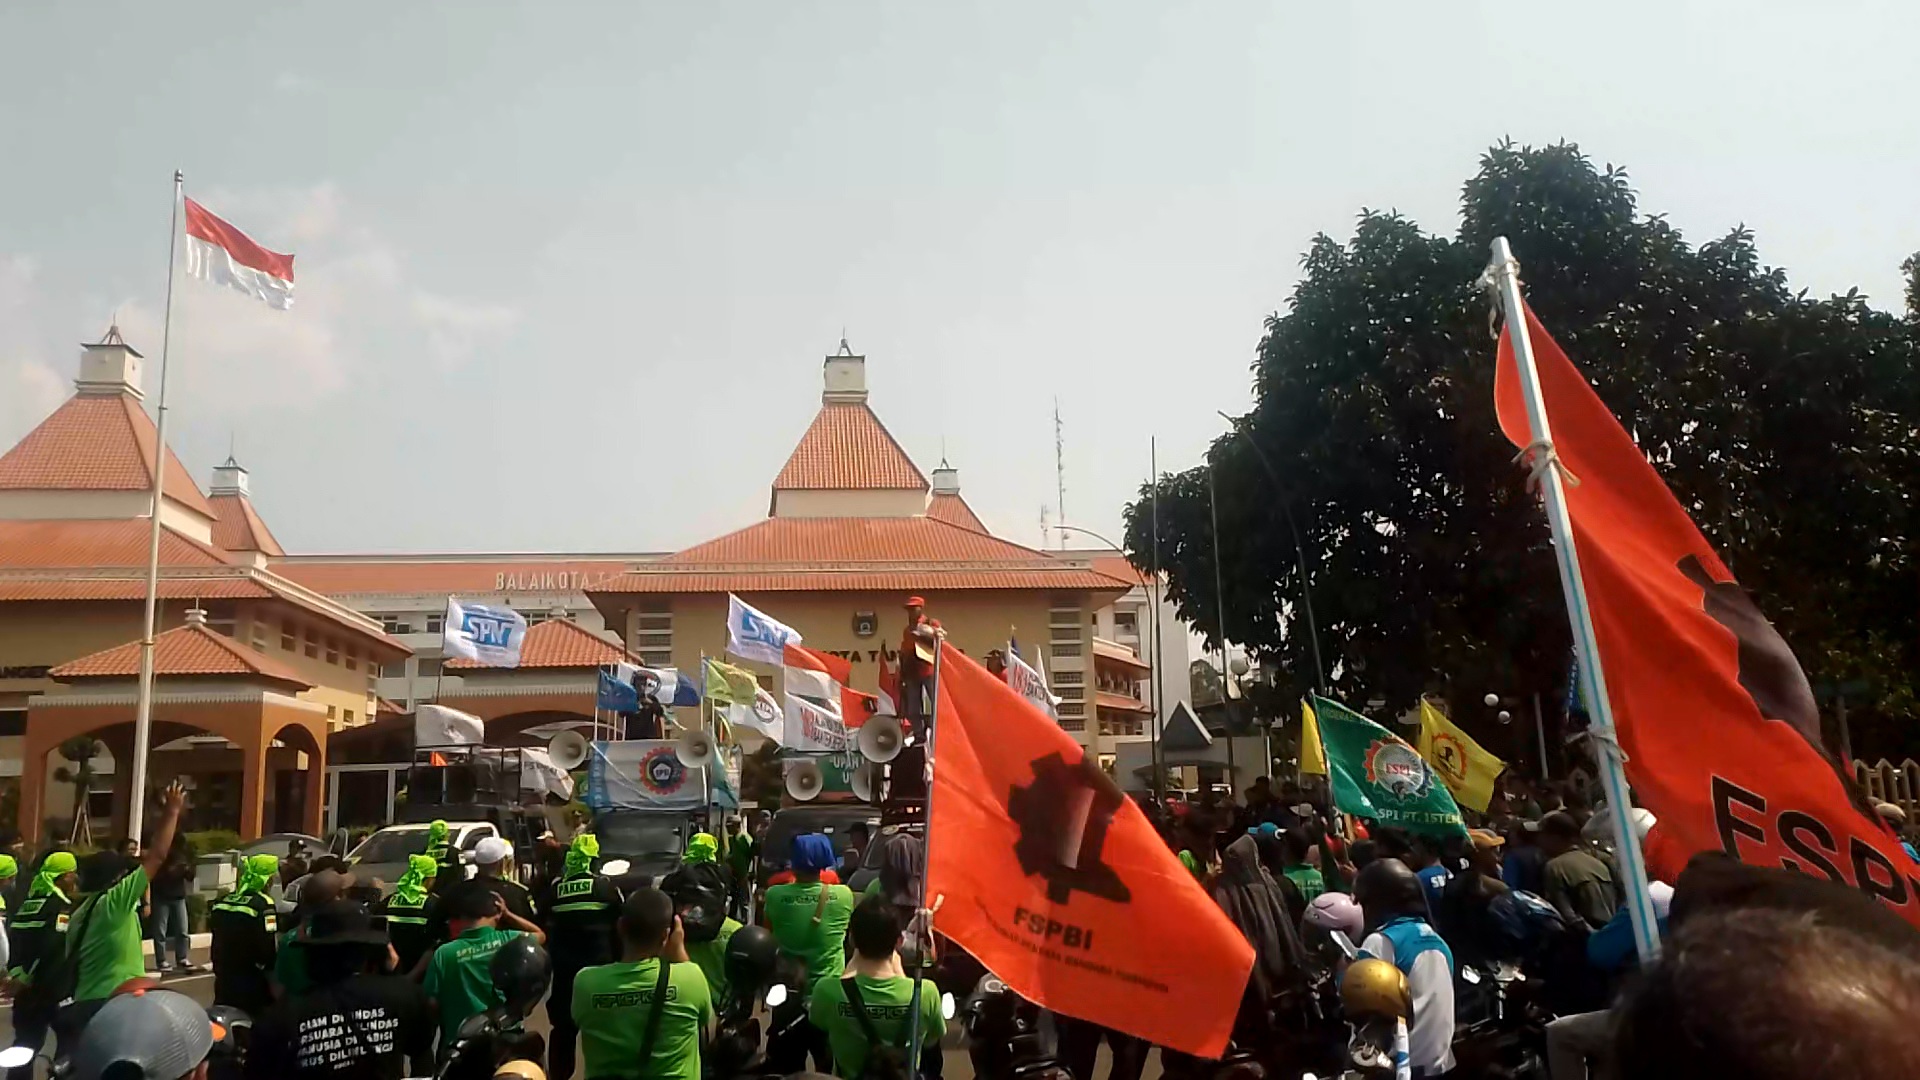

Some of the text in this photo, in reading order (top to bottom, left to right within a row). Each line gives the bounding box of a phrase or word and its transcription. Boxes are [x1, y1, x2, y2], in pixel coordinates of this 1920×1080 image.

[494, 571, 590, 591] BALAIKOTA
[1711, 773, 1920, 906] FSP
[1013, 906, 1094, 951] FSPBI
